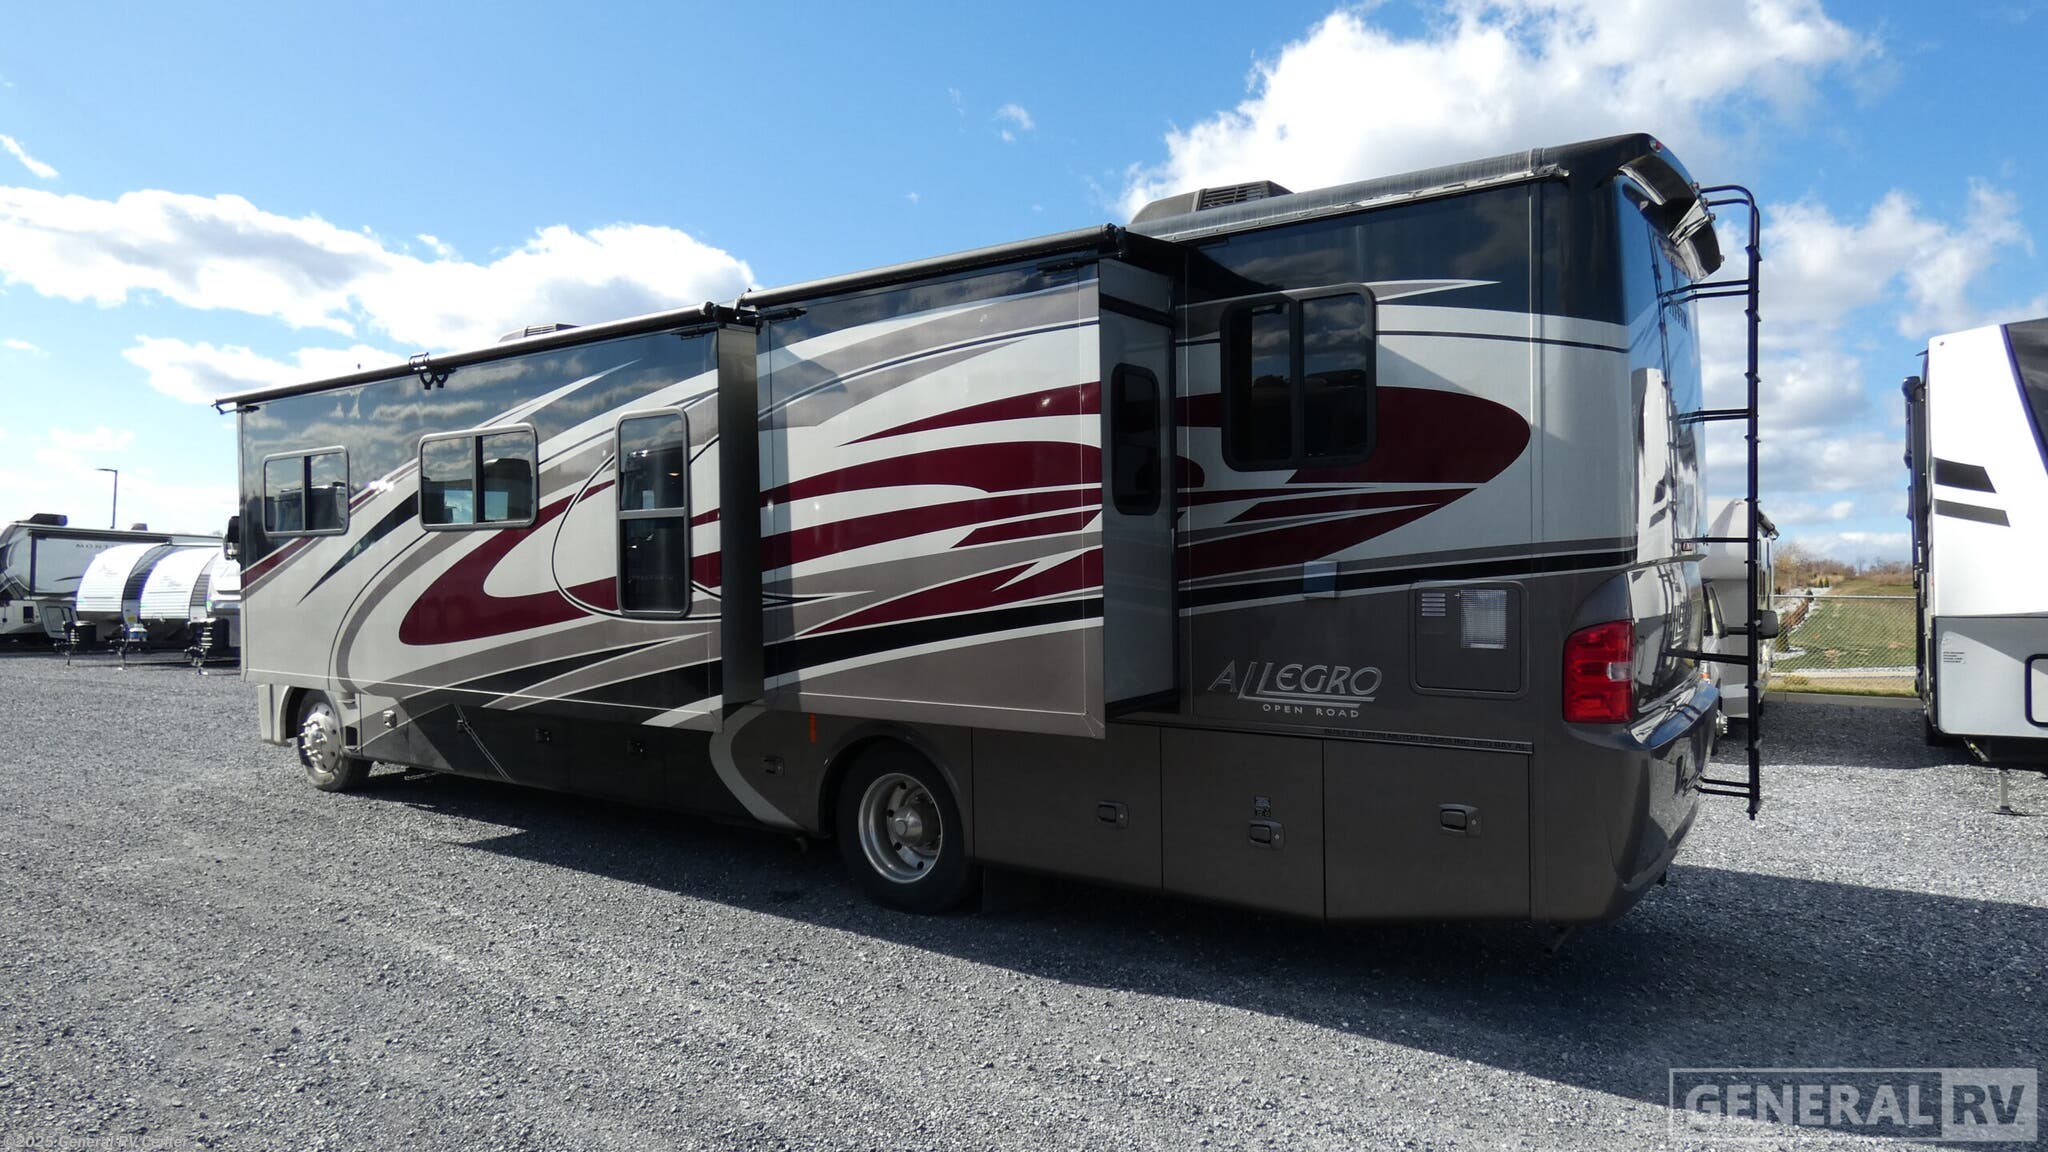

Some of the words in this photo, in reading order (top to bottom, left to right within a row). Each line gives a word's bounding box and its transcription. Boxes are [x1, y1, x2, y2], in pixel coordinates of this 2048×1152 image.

[1207, 659, 1382, 706] ALLEGRO
[1262, 703, 1303, 714] OPEN
[1315, 707, 1359, 718] ROAD
